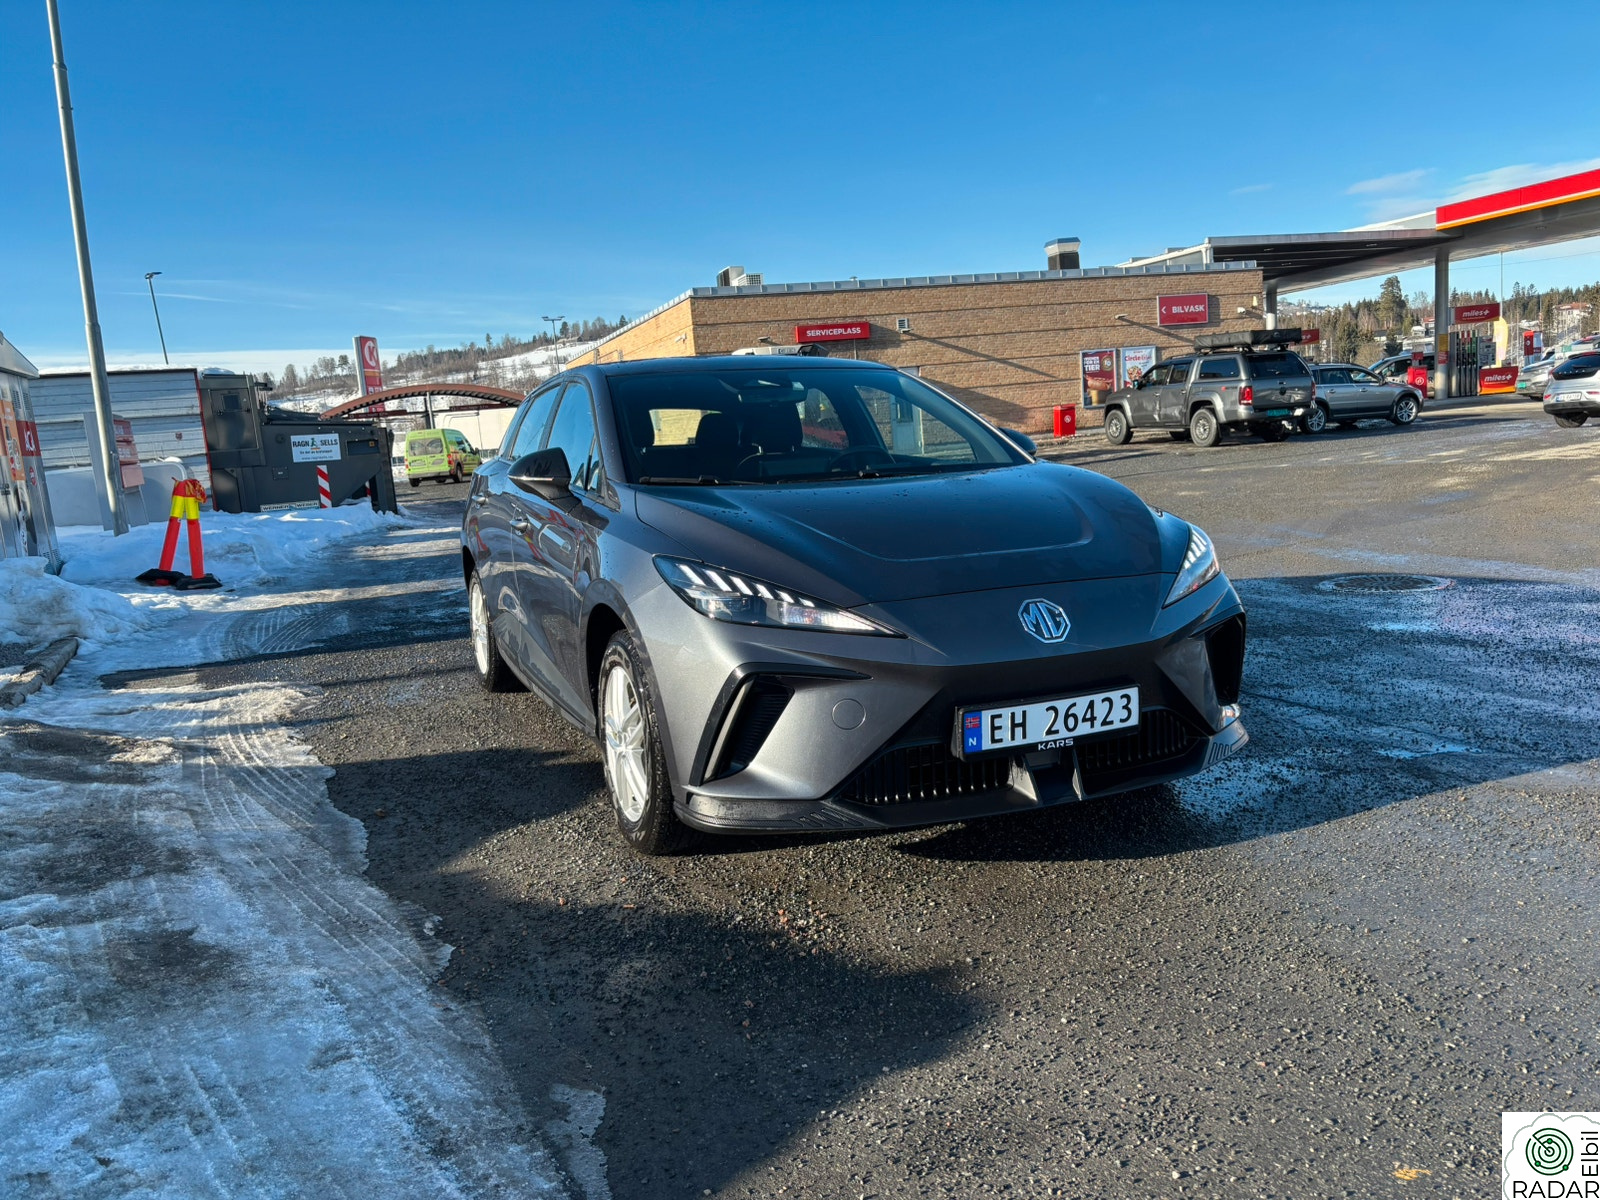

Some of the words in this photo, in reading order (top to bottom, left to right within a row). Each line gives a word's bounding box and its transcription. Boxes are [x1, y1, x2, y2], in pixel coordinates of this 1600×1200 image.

[1172, 304, 1205, 314] BILVASK
[806, 327, 862, 337] SERVICEPLASS
[1084, 364, 1100, 372] TIER
[1484, 374, 1512, 382] miles+
[292, 440, 310, 448] RAGN
[320, 438, 338, 446] SELLS
[1020, 600, 1068, 640] MG
[989, 709, 1028, 744] EH
[1043, 693, 1132, 737] 26423
[968, 736, 977, 747] N
[1037, 737, 1074, 751] KARS
